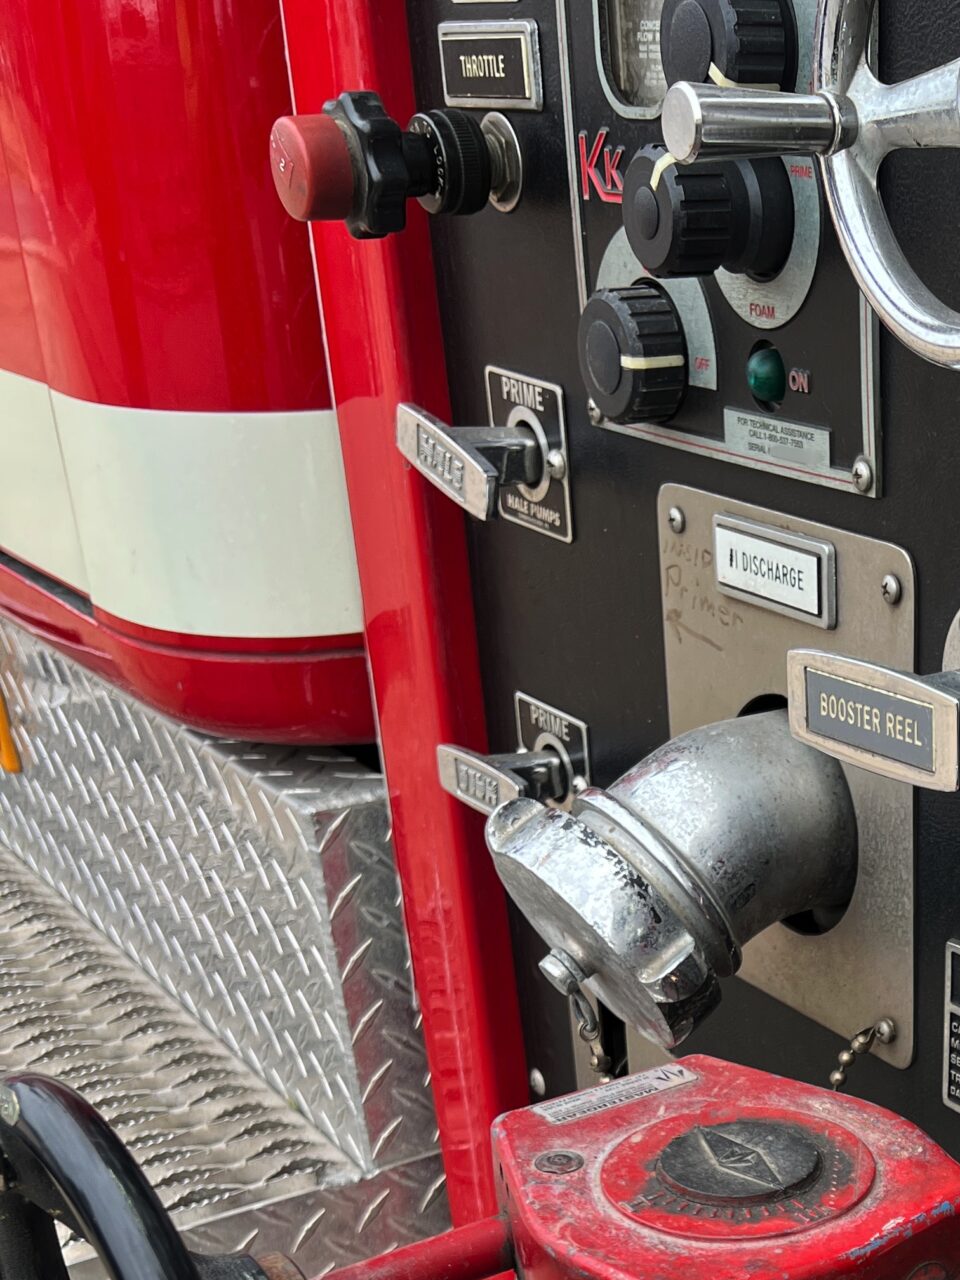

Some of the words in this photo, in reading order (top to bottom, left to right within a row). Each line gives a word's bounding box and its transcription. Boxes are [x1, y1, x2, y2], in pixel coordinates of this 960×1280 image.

[459, 54, 506, 78] THROTTLE
[790, 165, 813, 179] PRIME
[749, 303, 775, 319] FOAM
[502, 376, 545, 412] PRIME
[788, 370, 809, 393] ON
[742, 551, 804, 591] DISCHARGE
[529, 704, 571, 741] PRIME
[820, 693, 881, 734] BOOSTER
[886, 713, 922, 746] REEL
